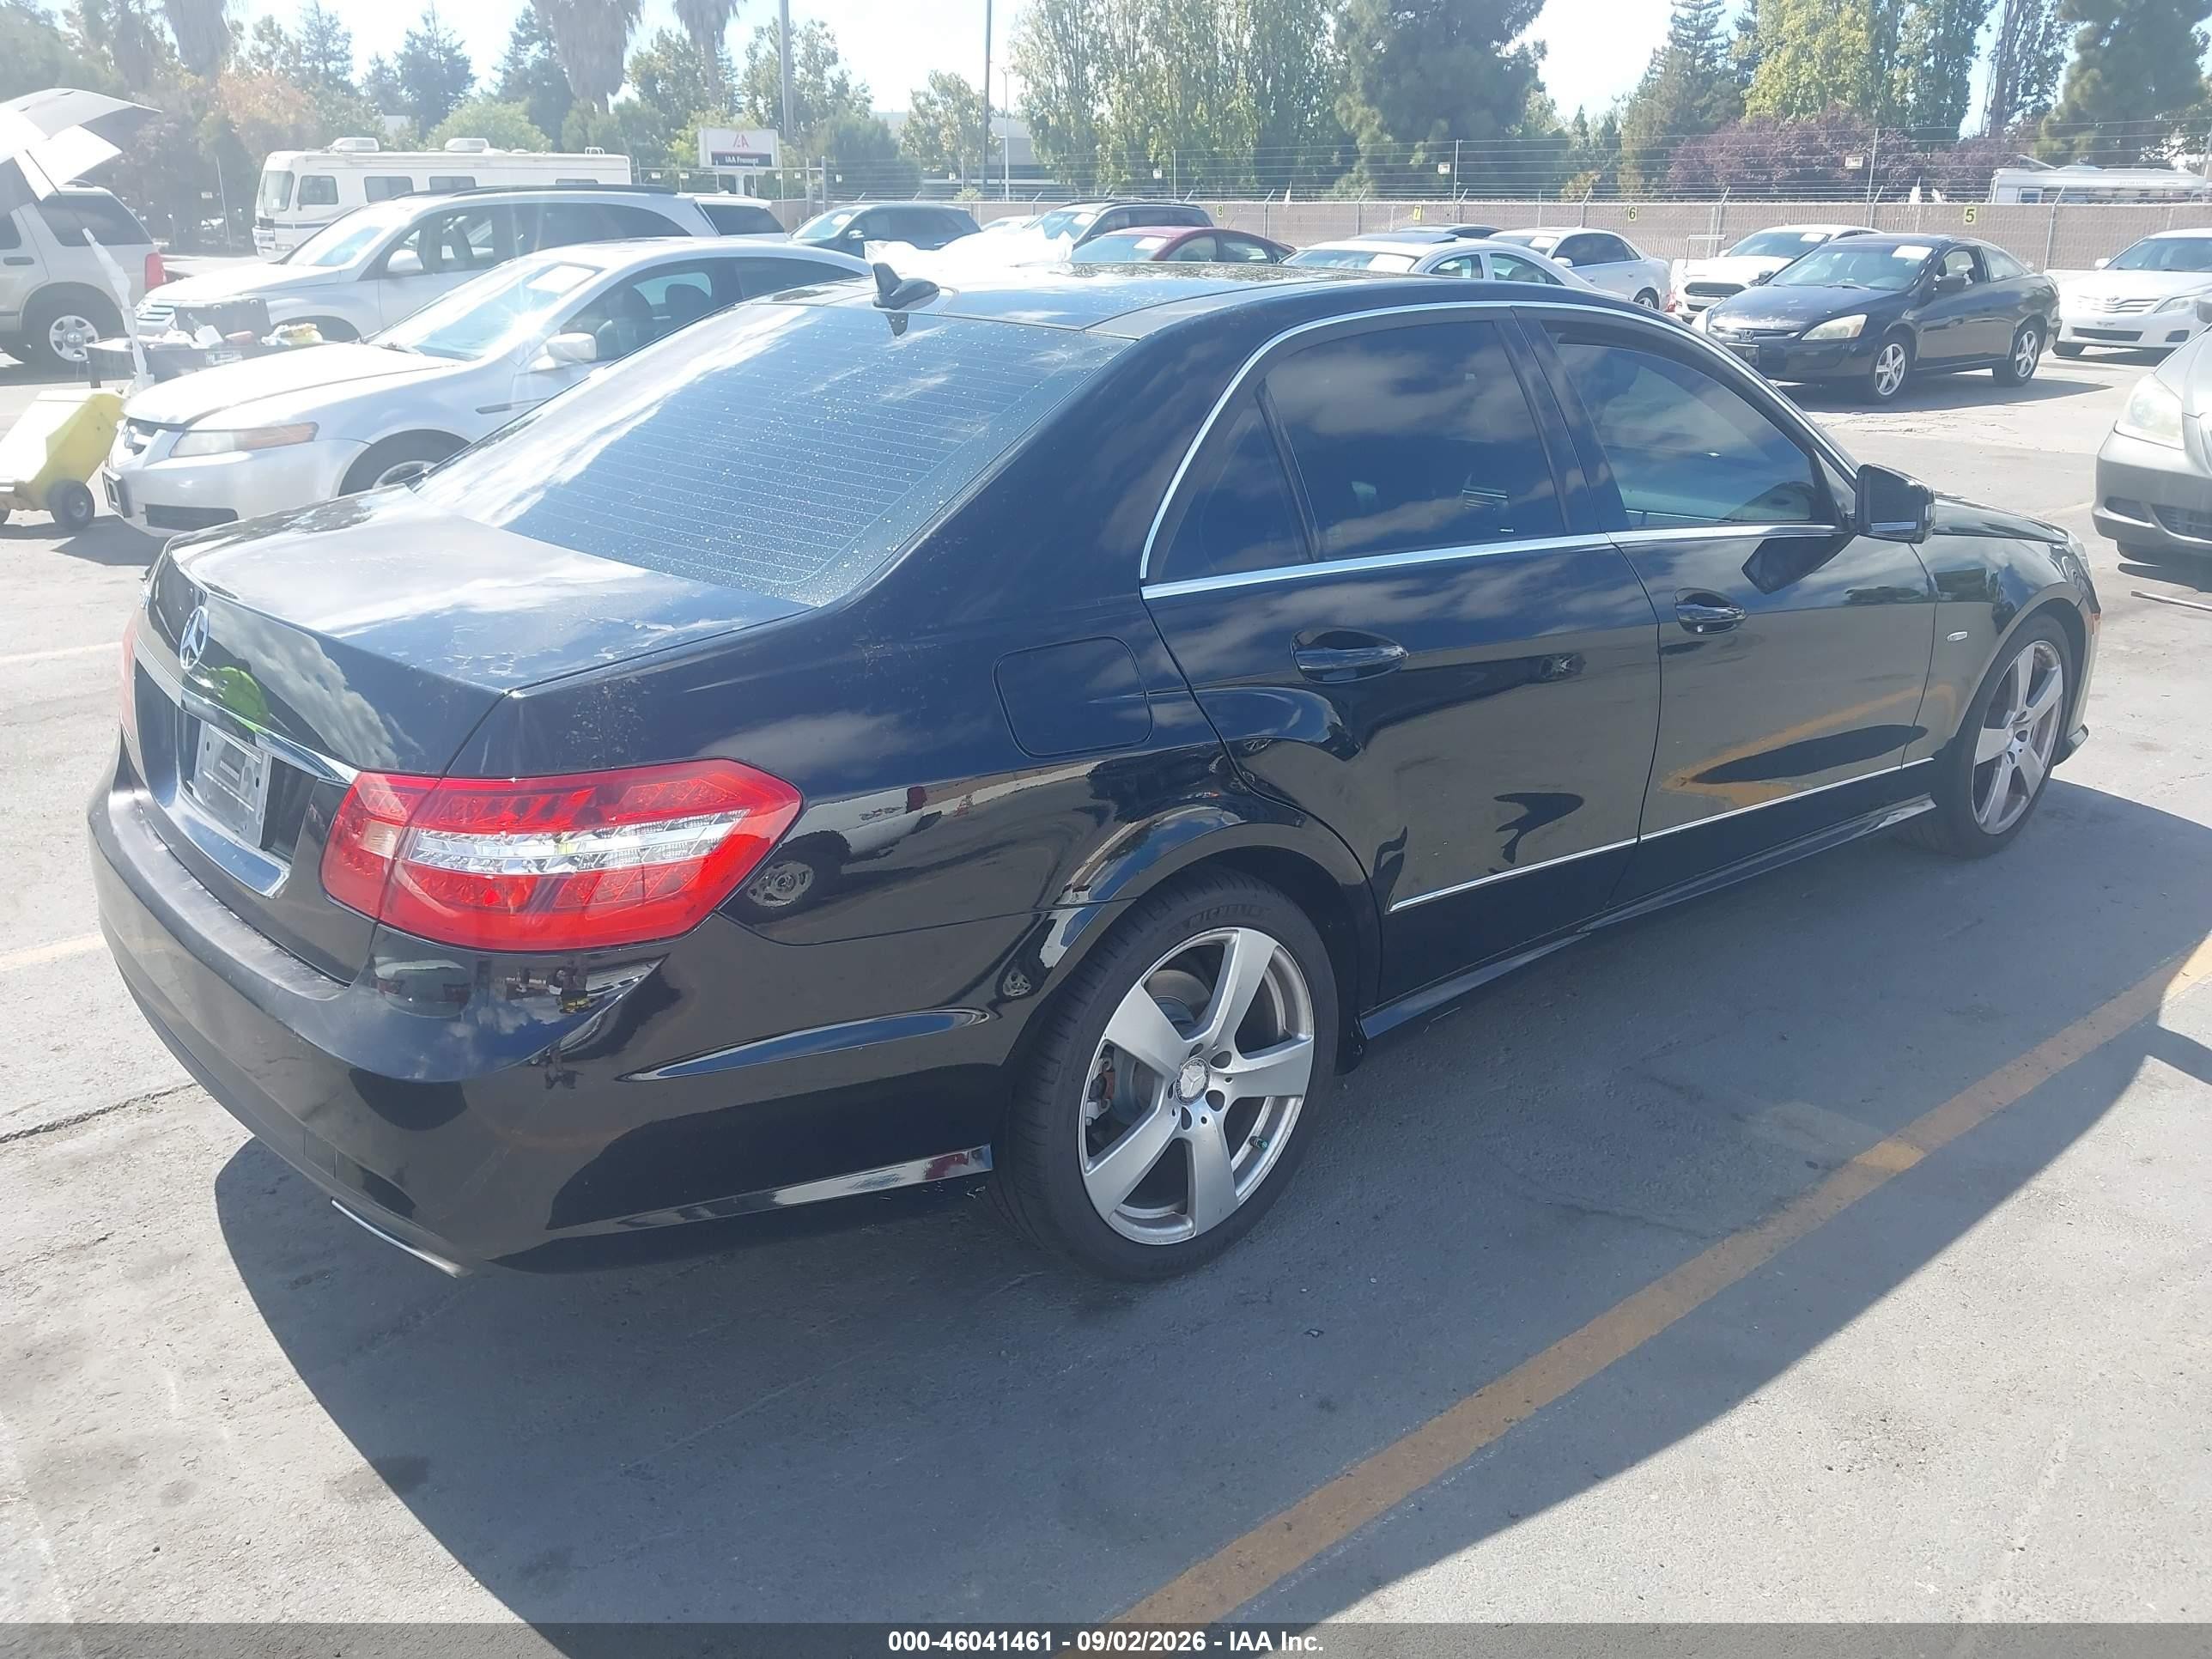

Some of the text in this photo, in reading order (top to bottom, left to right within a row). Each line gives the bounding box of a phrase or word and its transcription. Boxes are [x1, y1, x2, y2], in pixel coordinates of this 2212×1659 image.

[1218, 205, 1223, 216] 8
[1414, 206, 1419, 218] 7
[1629, 207, 1636, 220] 6
[1966, 209, 1975, 222] 5
